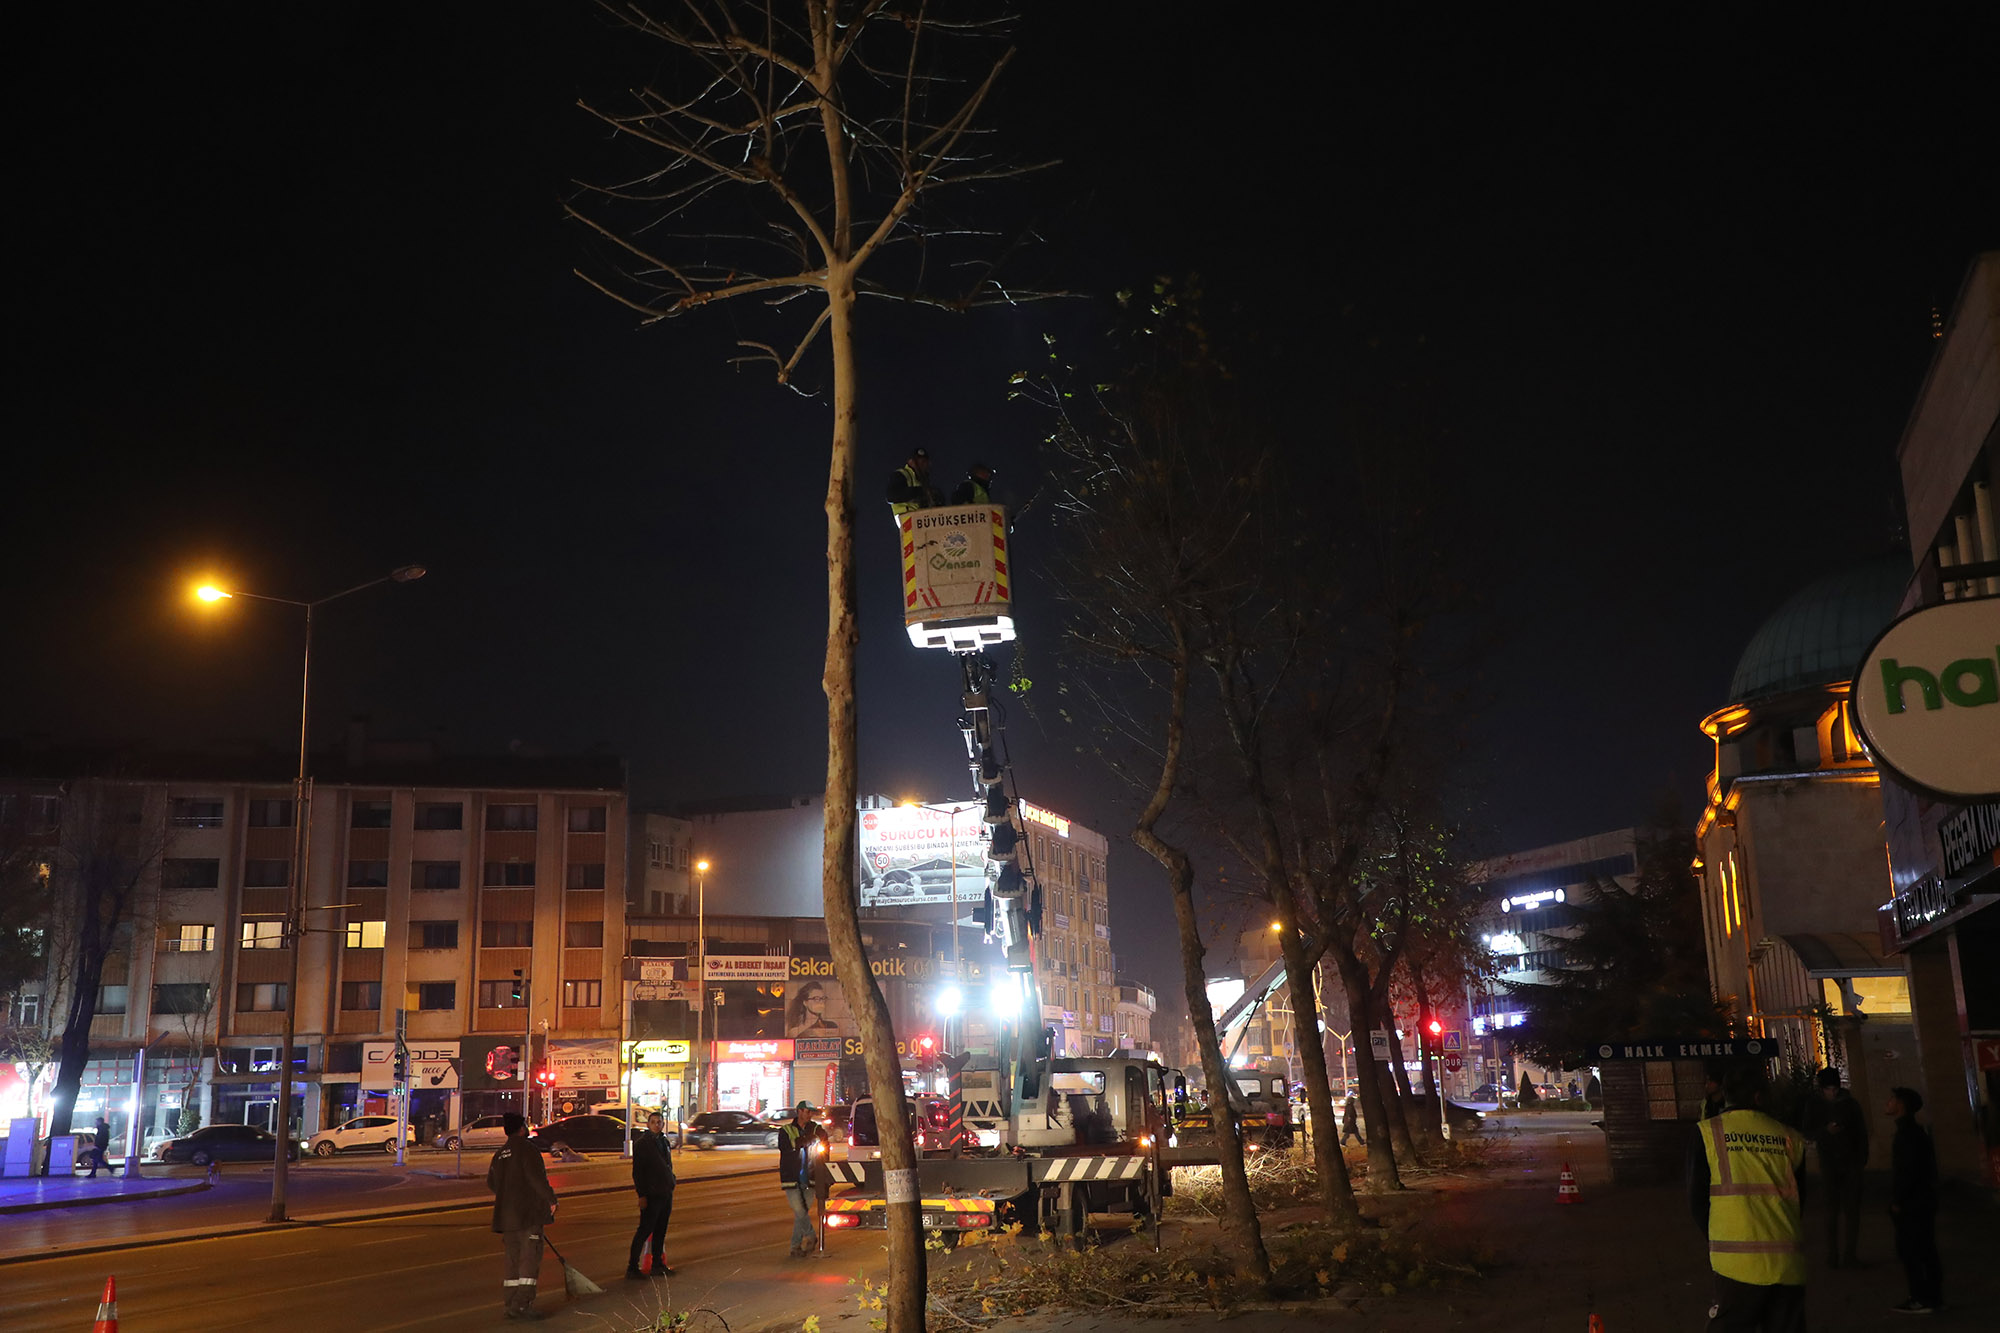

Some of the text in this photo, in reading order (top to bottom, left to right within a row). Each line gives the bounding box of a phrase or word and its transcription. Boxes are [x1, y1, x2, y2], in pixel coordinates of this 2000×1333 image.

[916, 510, 986, 529] BÜYÜKŞEHİR
[1880, 645, 2000, 715] ha
[878, 857, 888, 865] 50
[790, 957, 834, 976] Sakar
[1624, 1043, 1734, 1058] HALK EKMEK
[1446, 1058, 1461, 1066] DUR
